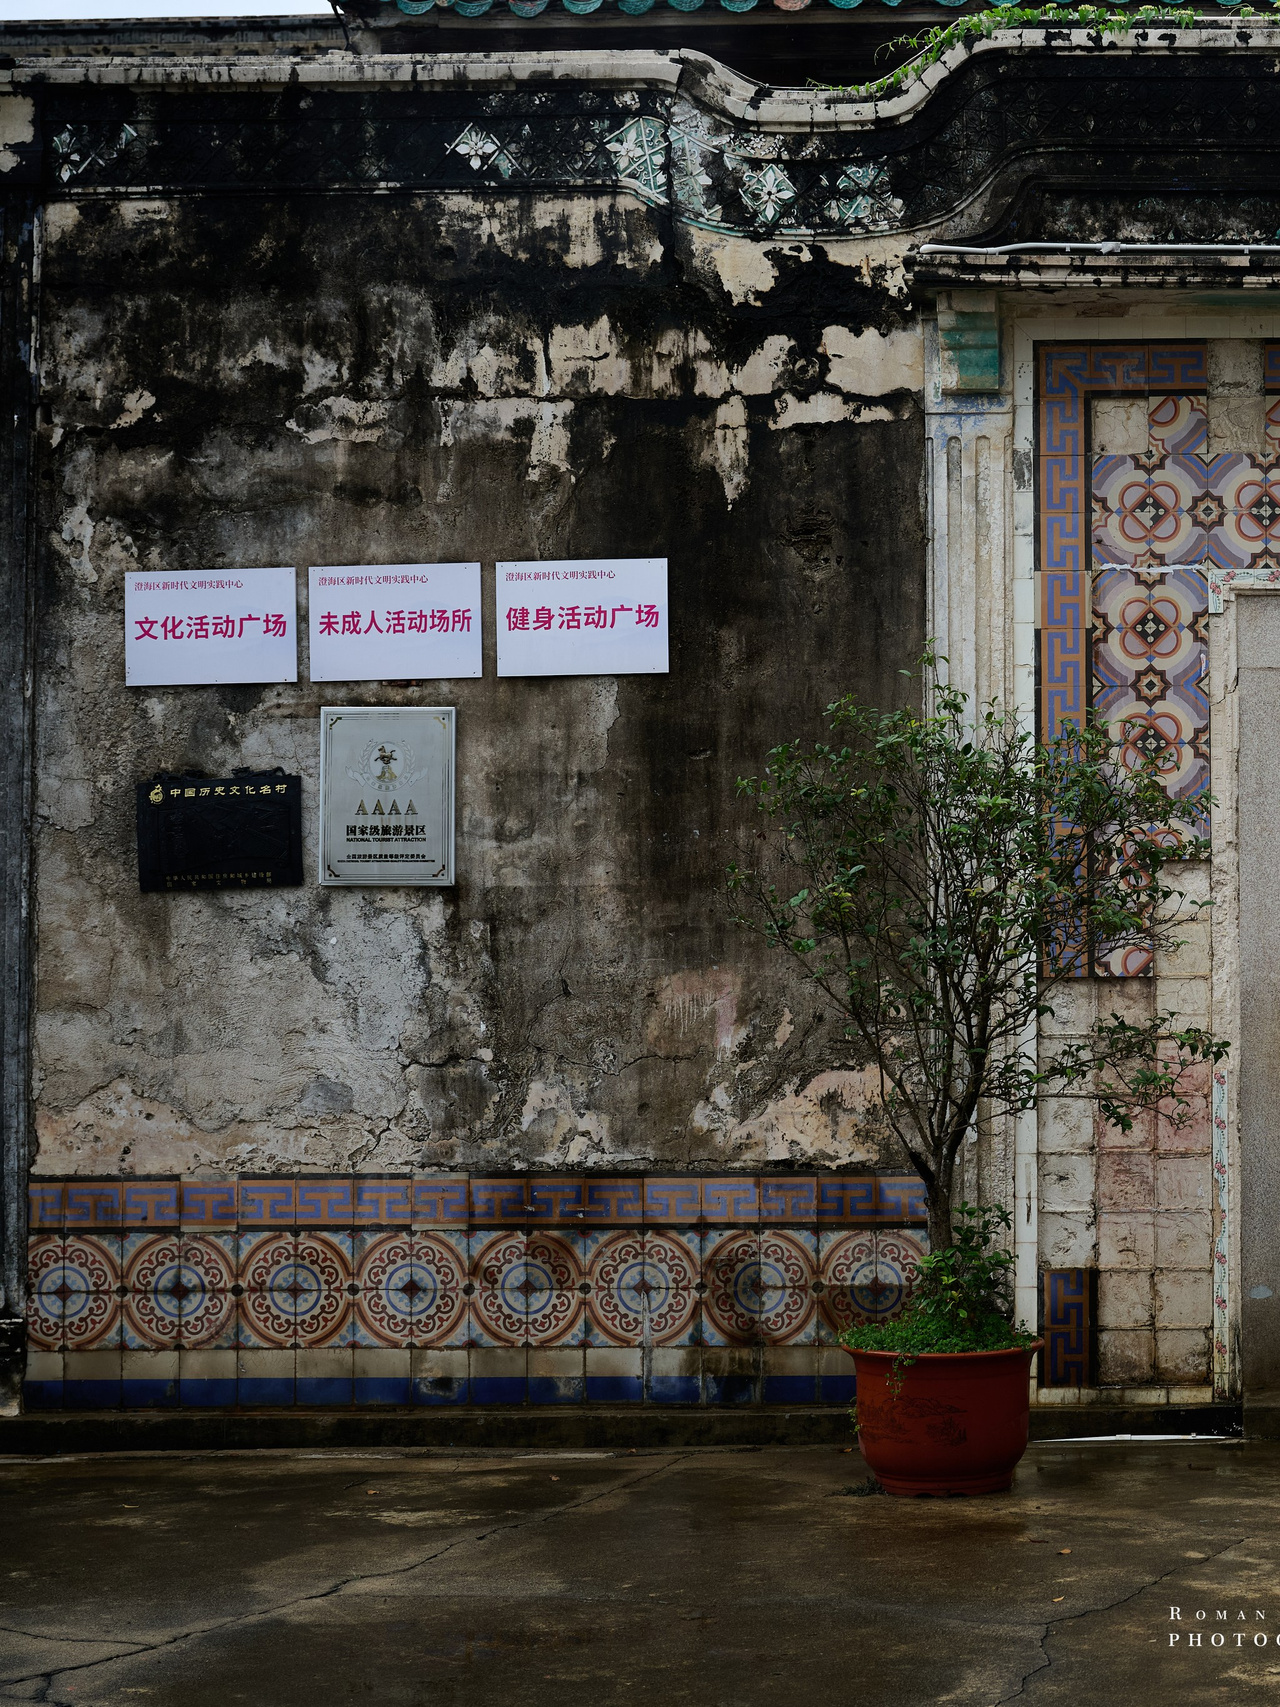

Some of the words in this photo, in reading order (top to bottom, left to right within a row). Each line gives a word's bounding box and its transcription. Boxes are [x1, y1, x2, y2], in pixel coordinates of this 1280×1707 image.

[318, 574, 429, 586] 澄海区新时代文明实践中心
[505, 570, 616, 582] 澄海区新时代文明实践中心
[134, 579, 244, 591] 澄海区新时代文明实践中心
[319, 608, 472, 636] 未成人活动场所
[505, 604, 660, 631] 健身活动广场
[134, 613, 287, 641] 文化活动广场
[346, 824, 426, 836] 国家级旅游景区
